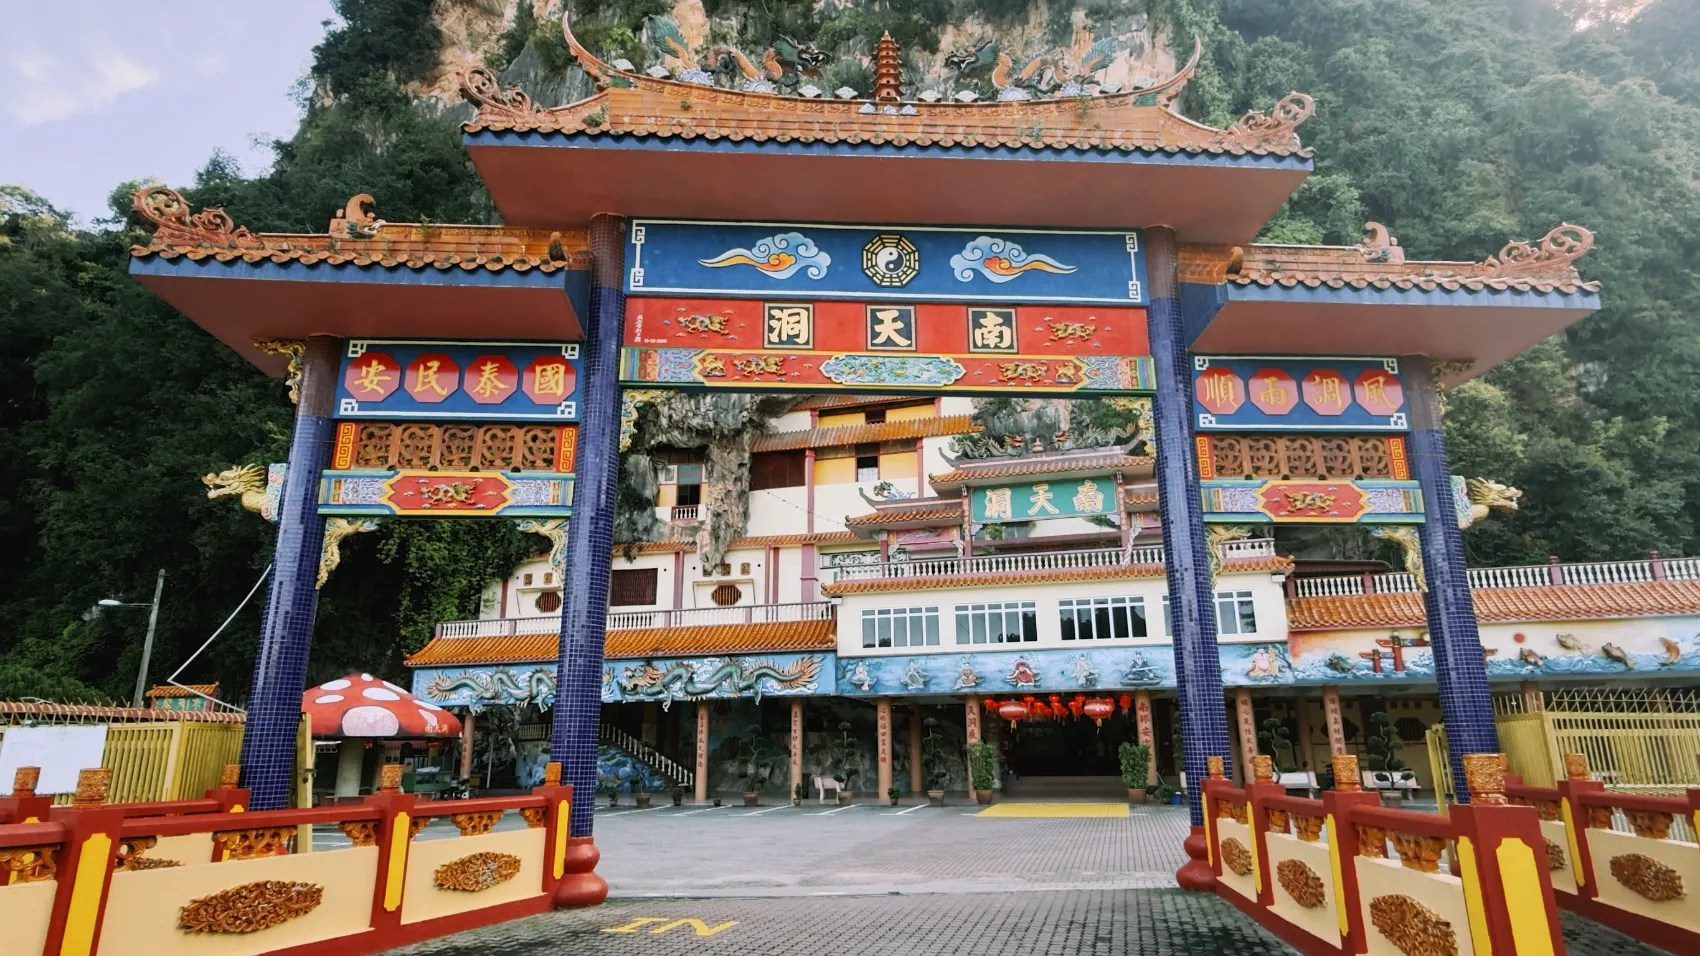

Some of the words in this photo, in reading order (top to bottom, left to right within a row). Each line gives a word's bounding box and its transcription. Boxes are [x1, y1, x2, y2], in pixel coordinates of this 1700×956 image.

[769, 307, 1012, 349] 南天洞
[354, 359, 566, 397] 國泰民安
[1204, 373, 1396, 409] 風調雨順
[984, 479, 1104, 519] 南天洞
[599, 915, 740, 937] IN
